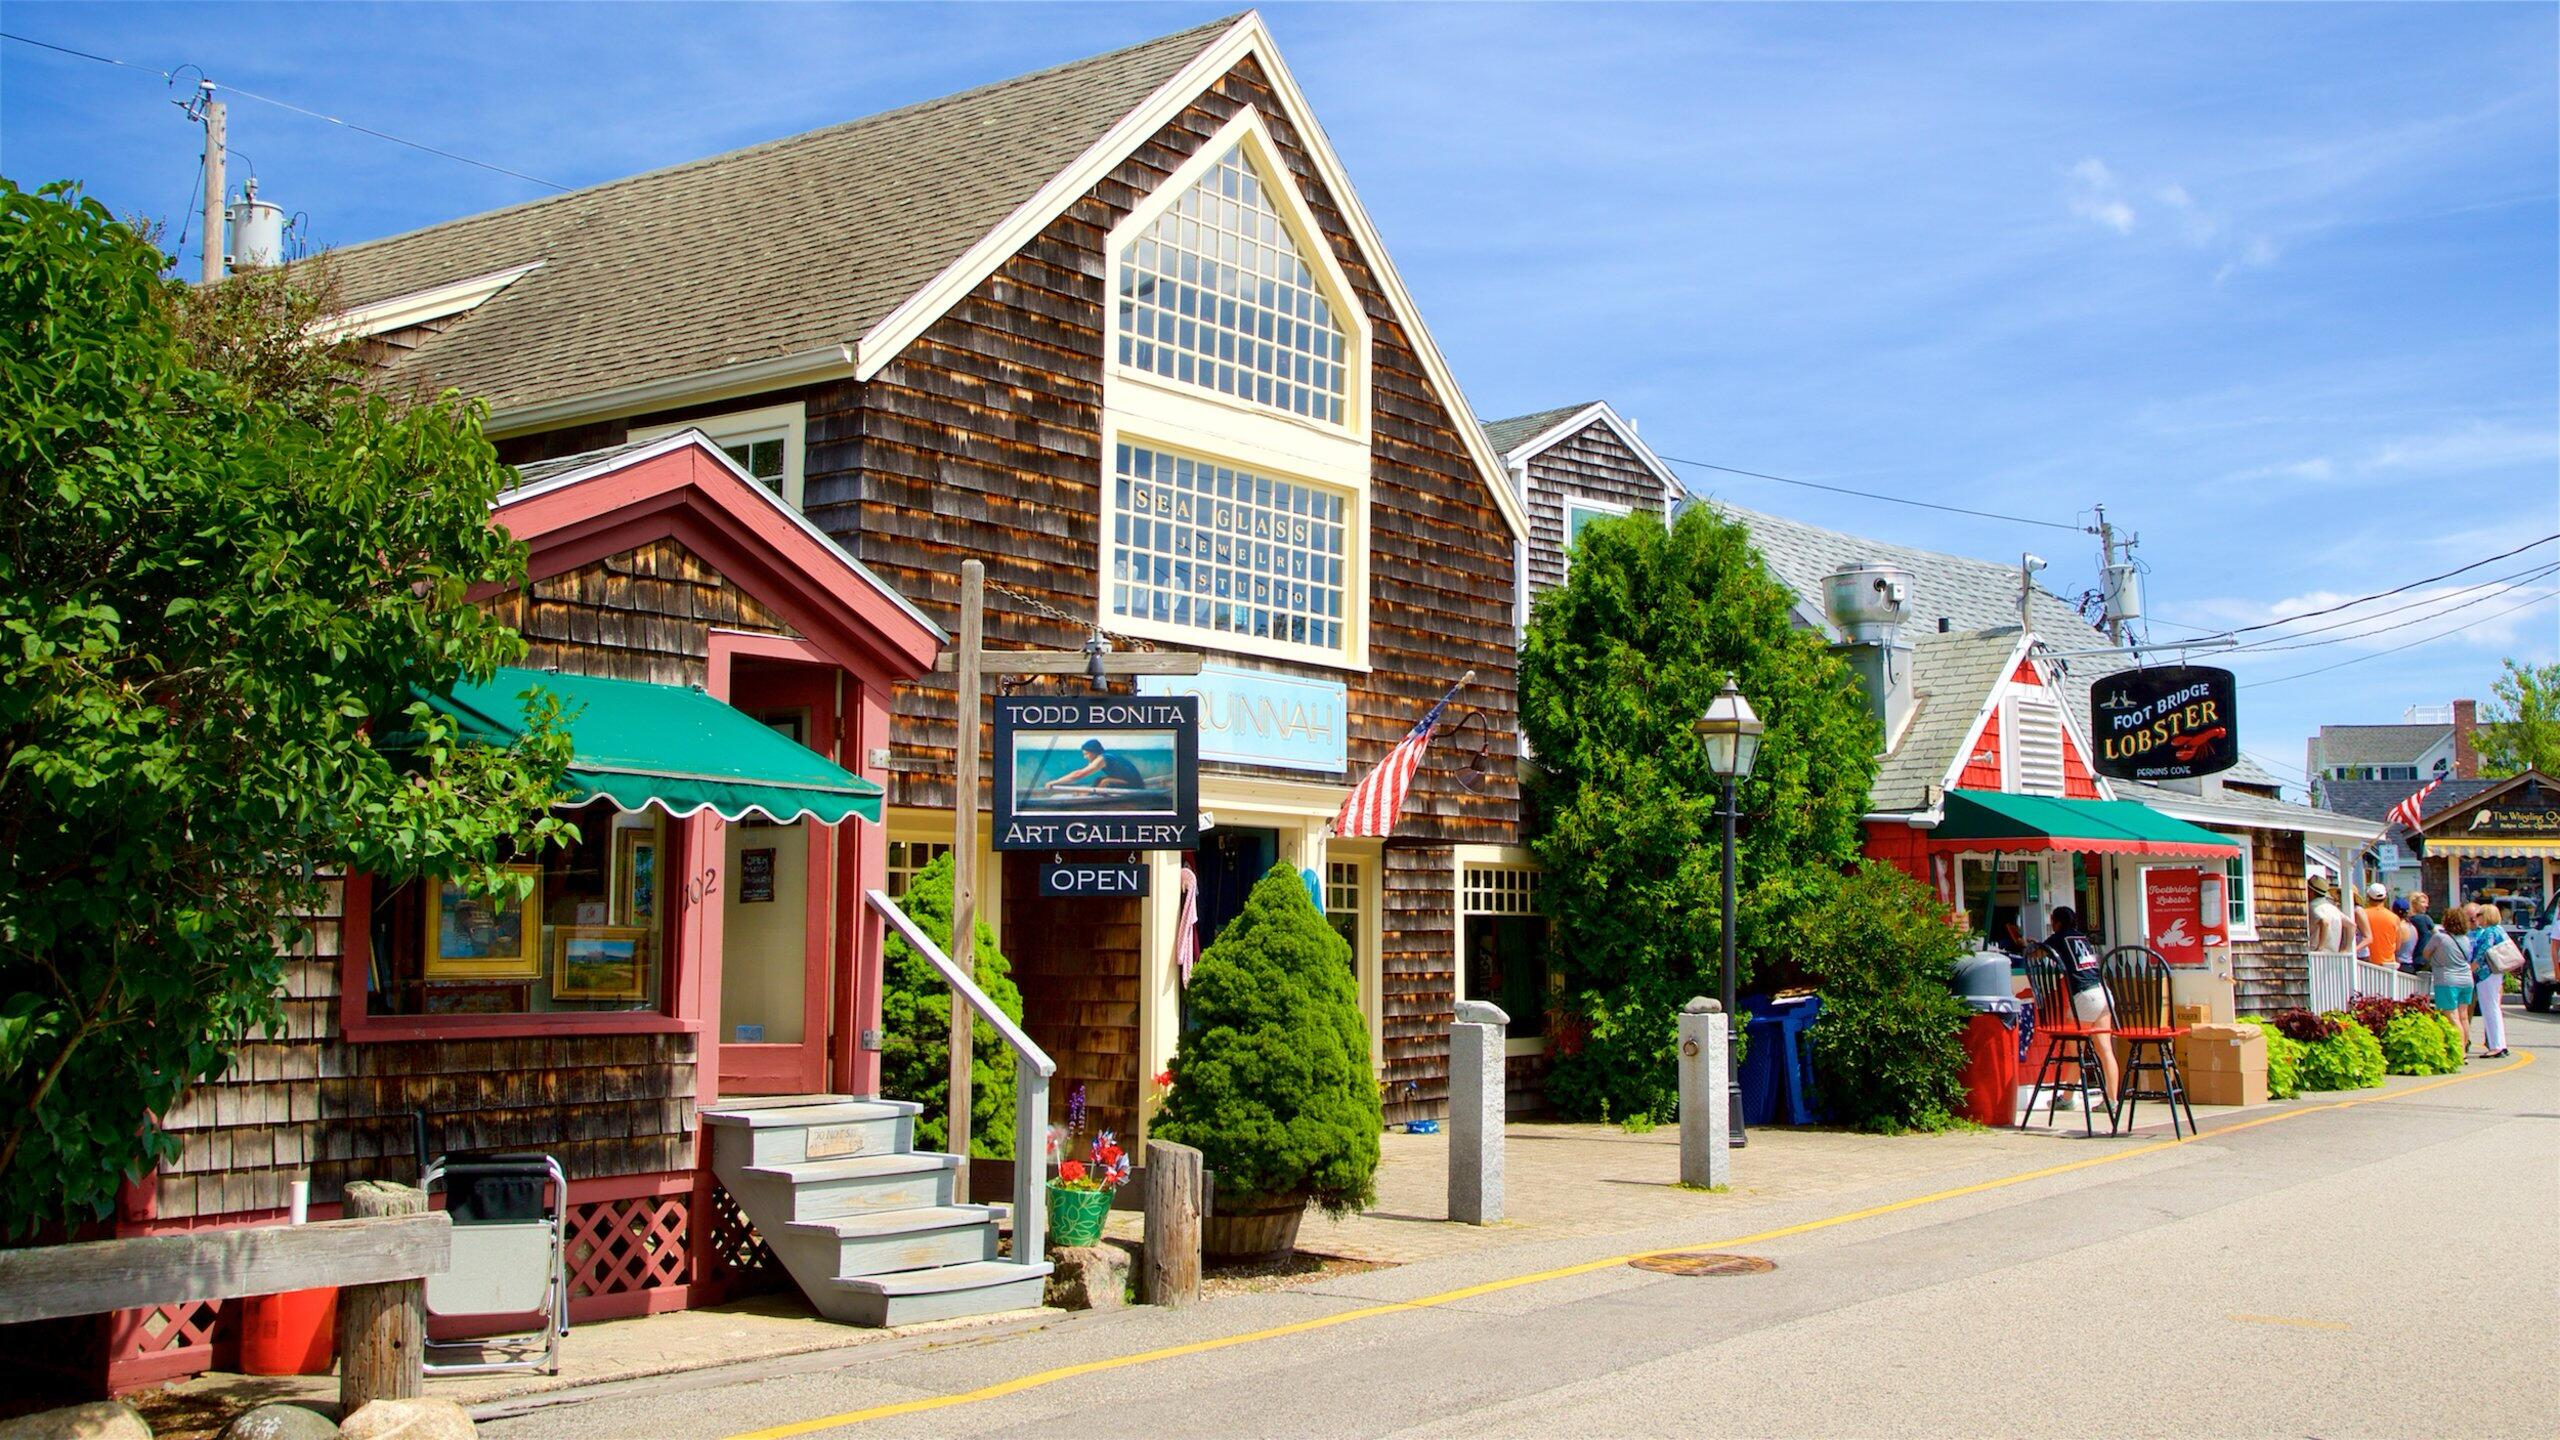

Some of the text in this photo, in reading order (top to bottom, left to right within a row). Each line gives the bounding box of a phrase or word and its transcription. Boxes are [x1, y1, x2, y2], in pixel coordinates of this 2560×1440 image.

[1136, 490, 1305, 543] SEA GLASS
[1179, 536, 1303, 572] JEWELRY
[1199, 573, 1304, 604] STUDIO
[1006, 704, 1186, 724] TODD BONITA
[1164, 686, 1333, 745] QUINNAH
[2113, 683, 2210, 730] FOOT BRIDGE
[2105, 700, 2220, 761] LOBSTER
[2136, 765, 2192, 778] PERKINS COVE
[2493, 811, 2508, 821] The
[684, 868, 717, 912] 102
[1050, 869, 1139, 891] OPEN
[2148, 884, 2198, 895] Footbridge
[2156, 895, 2192, 905] Lobster
